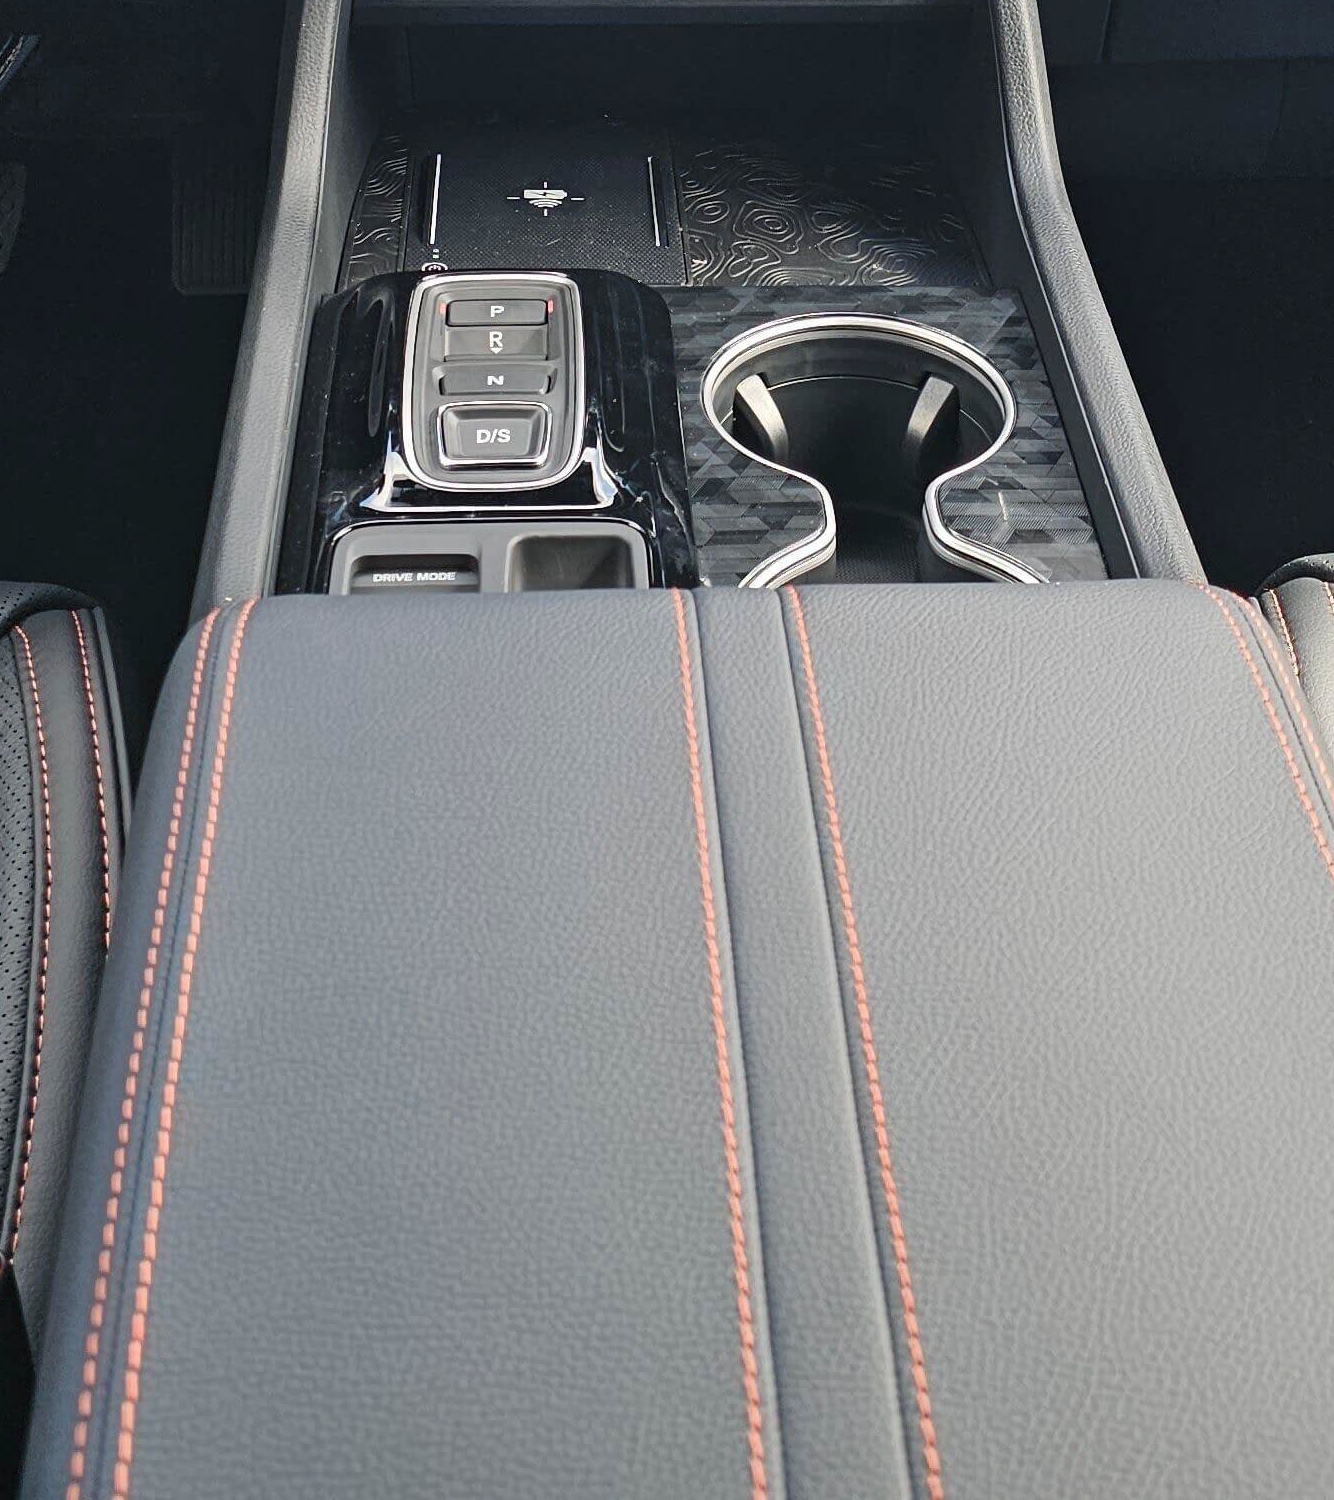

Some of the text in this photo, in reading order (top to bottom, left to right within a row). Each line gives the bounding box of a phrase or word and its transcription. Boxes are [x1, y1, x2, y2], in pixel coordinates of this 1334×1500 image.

[490, 306, 505, 318] P
[489, 332, 503, 348] R
[487, 375, 505, 386] N
[475, 428, 511, 444] D/S
[373, 572, 457, 582] DRIVE MODE
